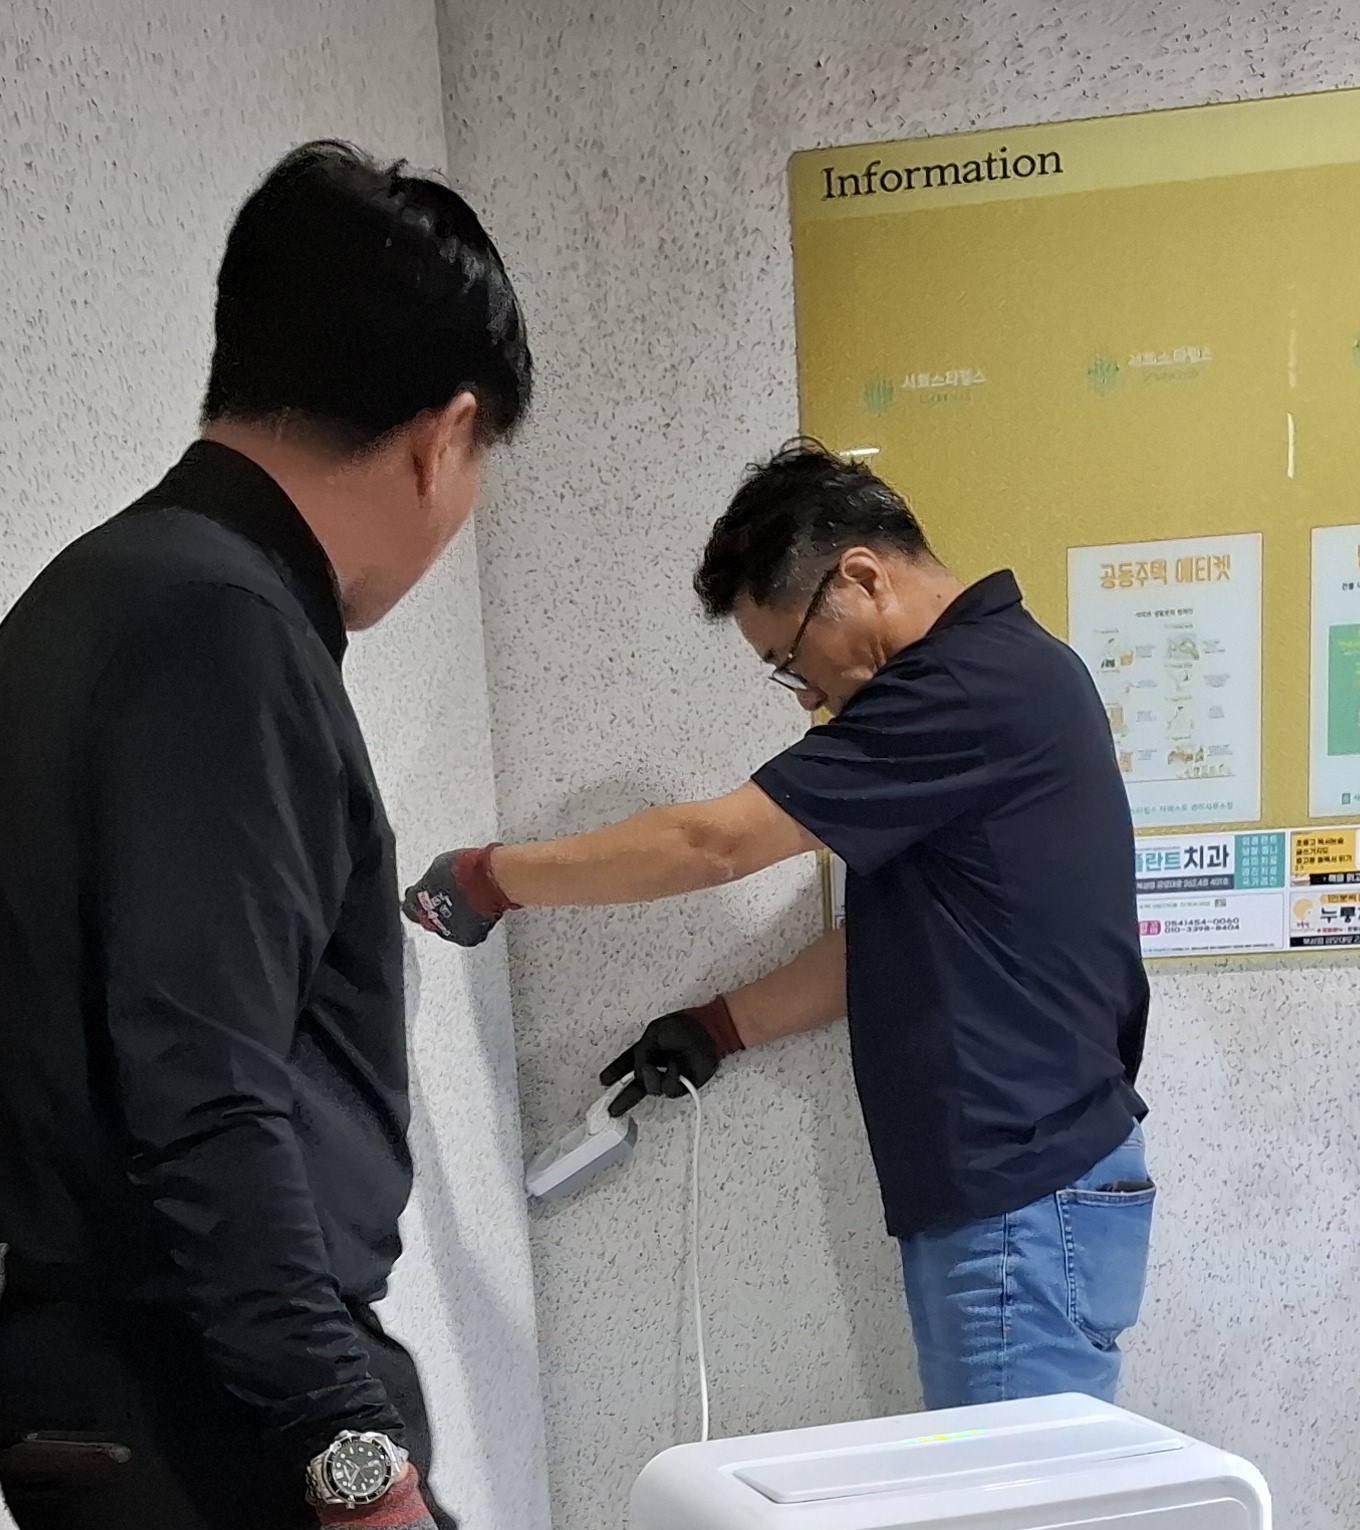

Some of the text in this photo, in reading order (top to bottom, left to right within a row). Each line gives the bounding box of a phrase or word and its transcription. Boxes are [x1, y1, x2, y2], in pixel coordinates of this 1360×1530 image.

[821, 146, 1064, 200] Information
[1100, 554, 1231, 590] 공동주택 에티켓
